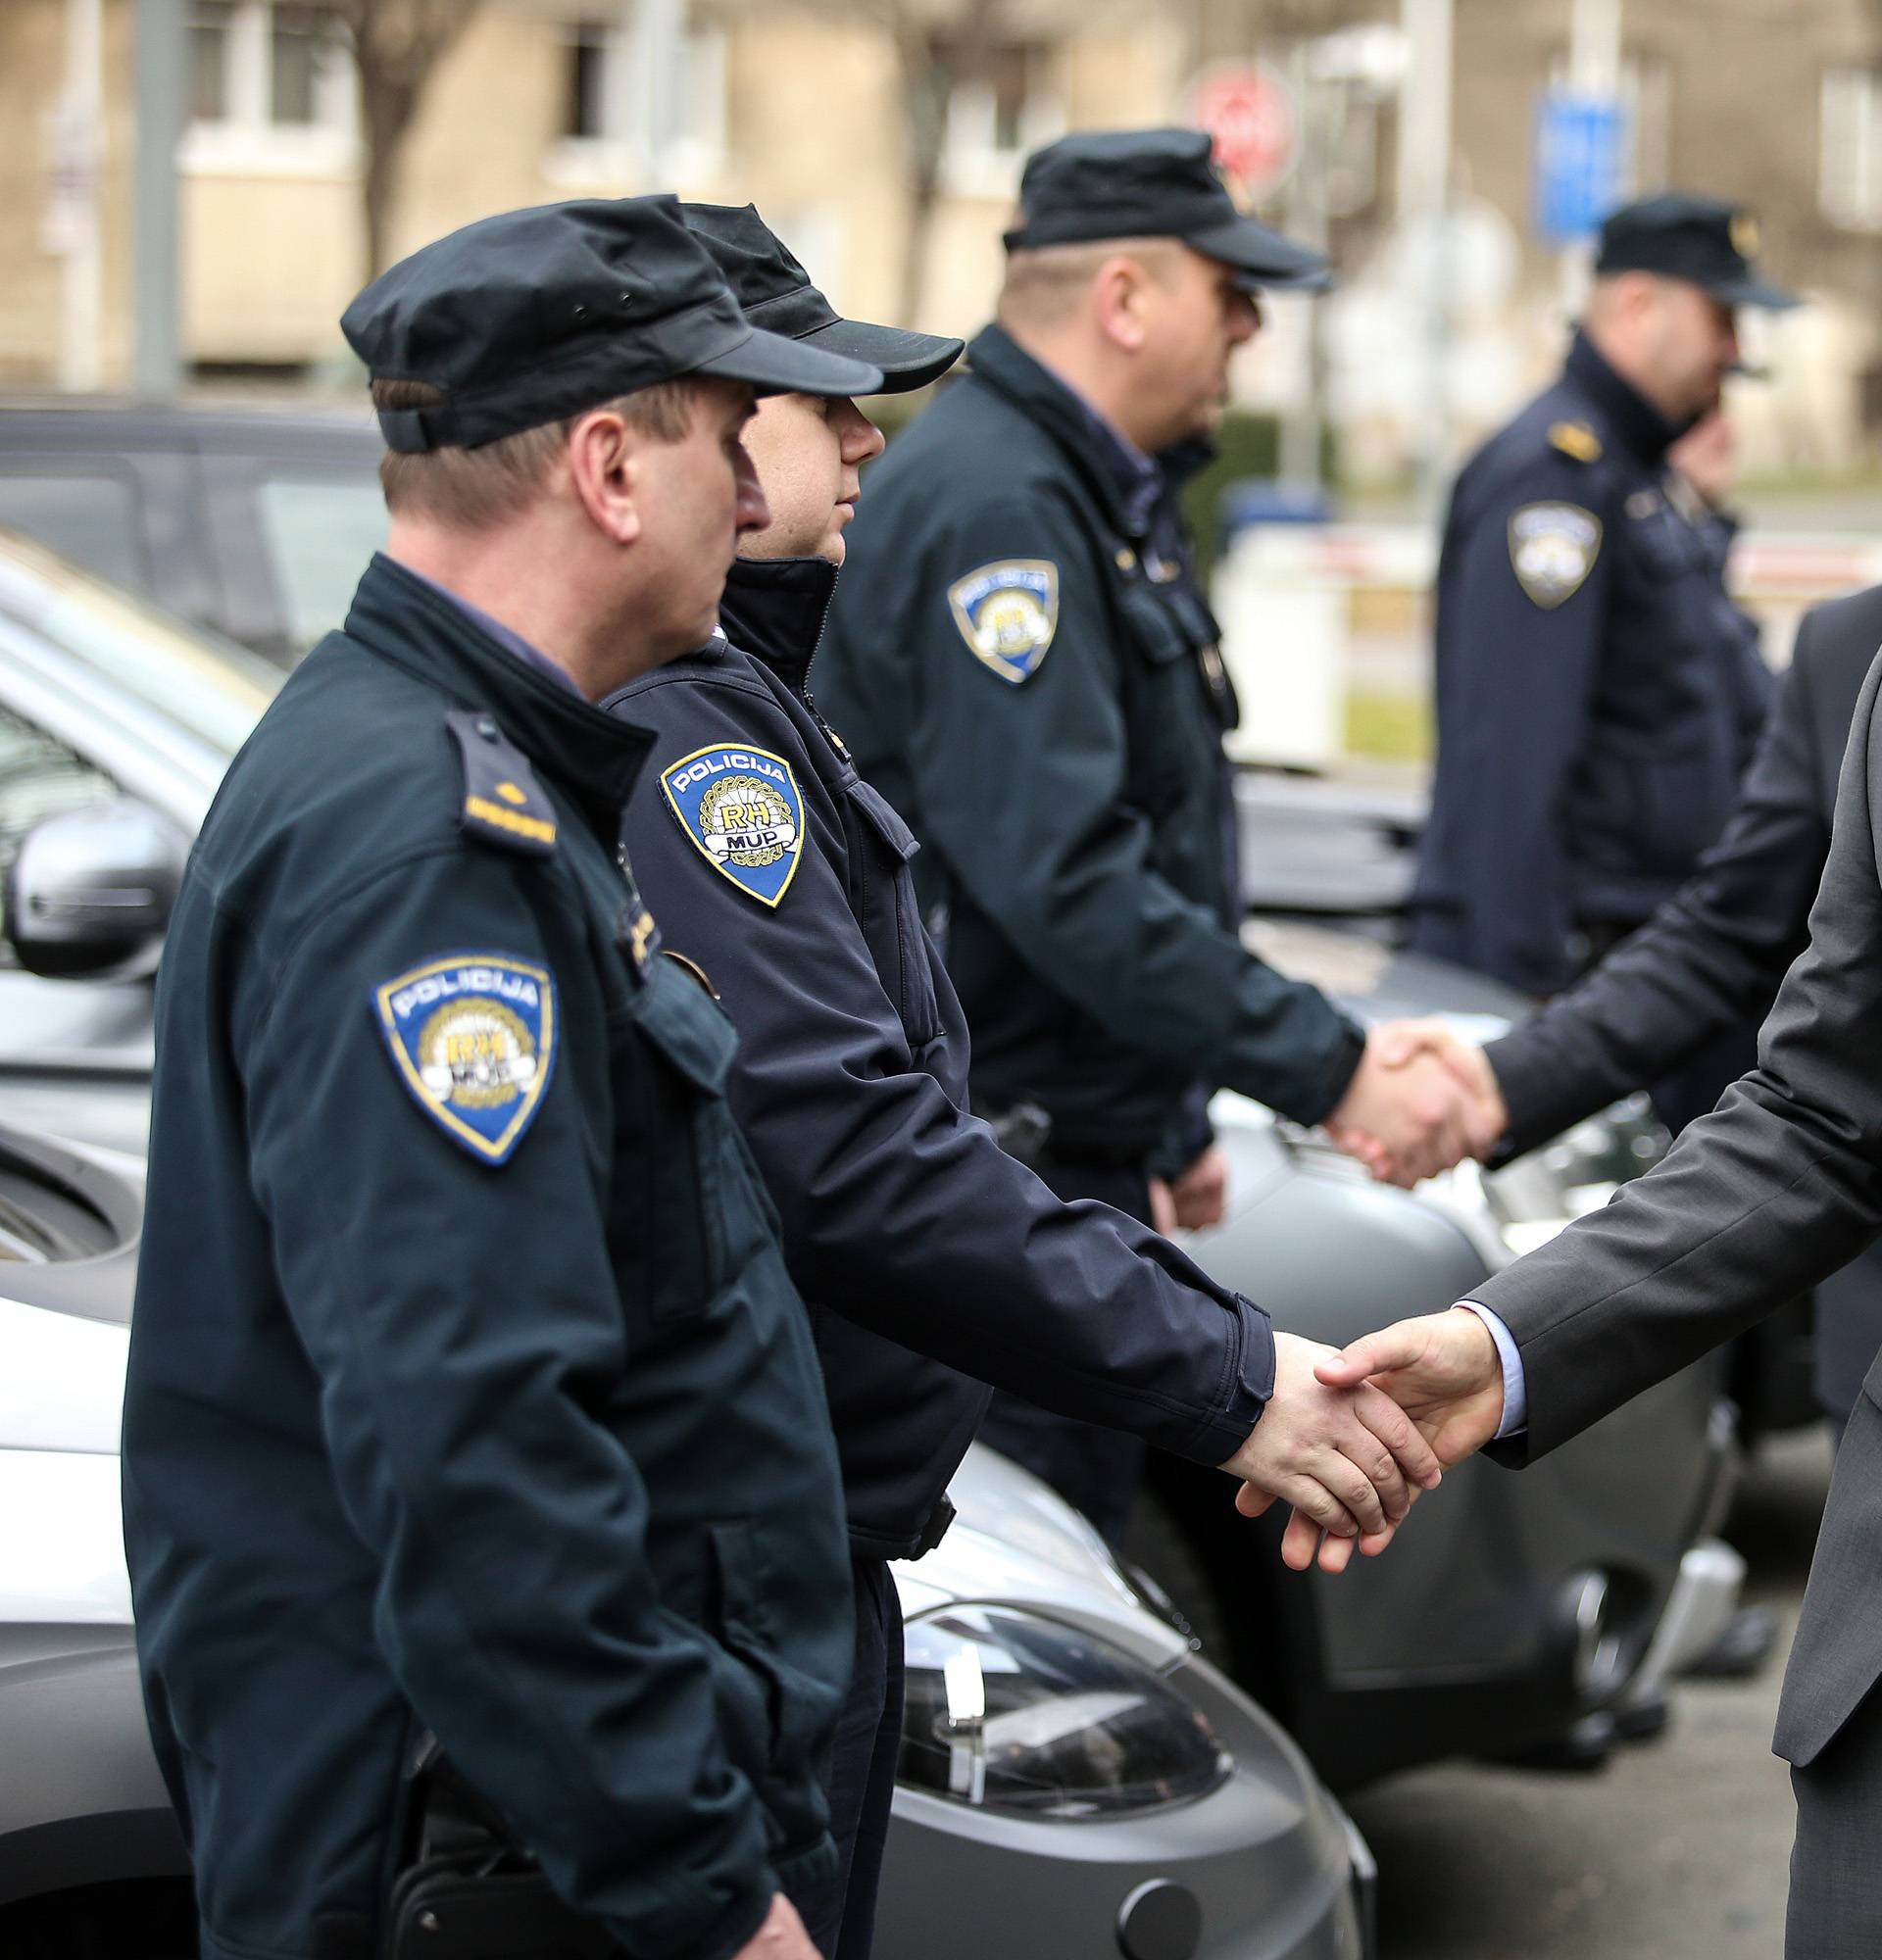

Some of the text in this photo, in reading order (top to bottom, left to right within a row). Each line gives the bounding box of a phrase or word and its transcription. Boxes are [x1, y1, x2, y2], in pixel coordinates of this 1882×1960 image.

[671, 754, 786, 793] POLICIJA
[719, 802, 771, 831] RH
[725, 830, 778, 850] MUP
[390, 967, 538, 1017] POLICIJA
[448, 1033, 505, 1064] RH
